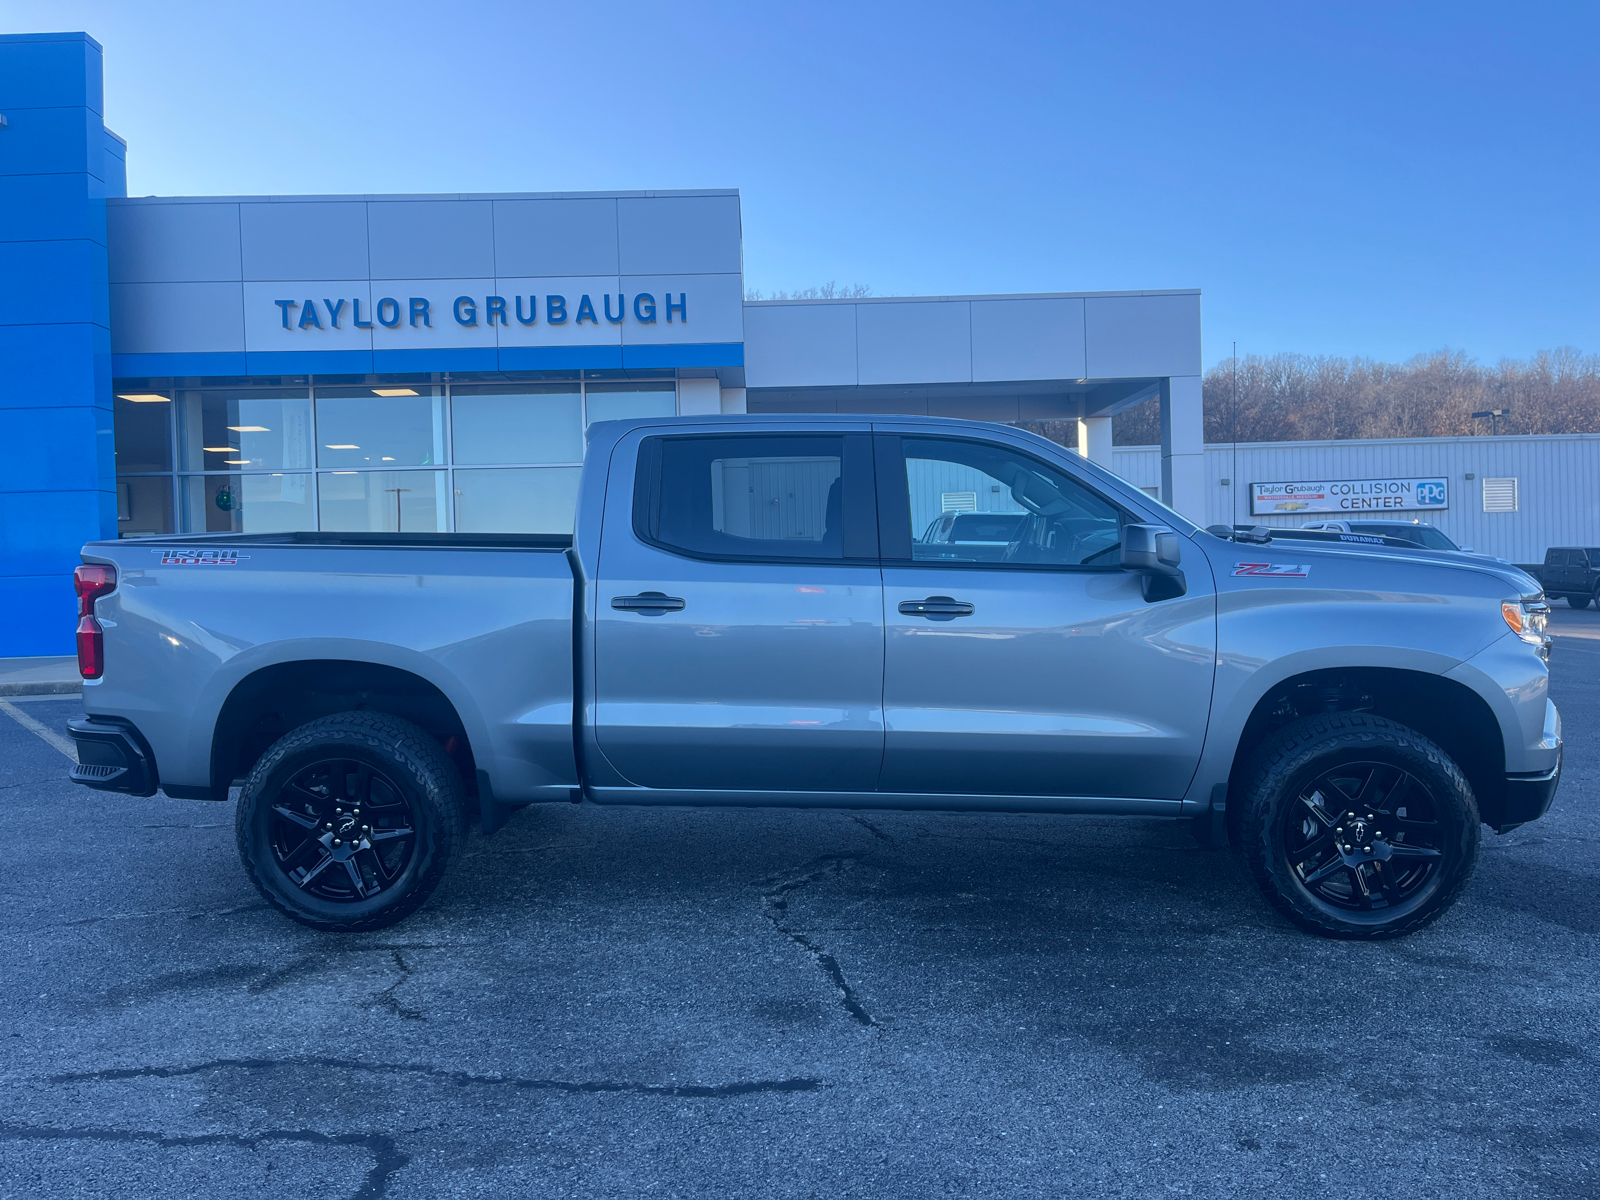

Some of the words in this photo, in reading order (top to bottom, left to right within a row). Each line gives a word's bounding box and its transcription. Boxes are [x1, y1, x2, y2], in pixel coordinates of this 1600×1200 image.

[274, 297, 432, 330] TAYLOR
[453, 293, 687, 327] GRUBAUGH
[1257, 485, 1283, 494] Taylor
[1285, 484, 1325, 494] Grubaugh
[1330, 482, 1411, 495] COLLISION
[1417, 484, 1444, 503] PPG
[1340, 496, 1404, 509] CENTER
[1340, 535, 1385, 544] DURAMAX
[151, 549, 250, 559] TRAIL
[1230, 562, 1312, 578] Z71
